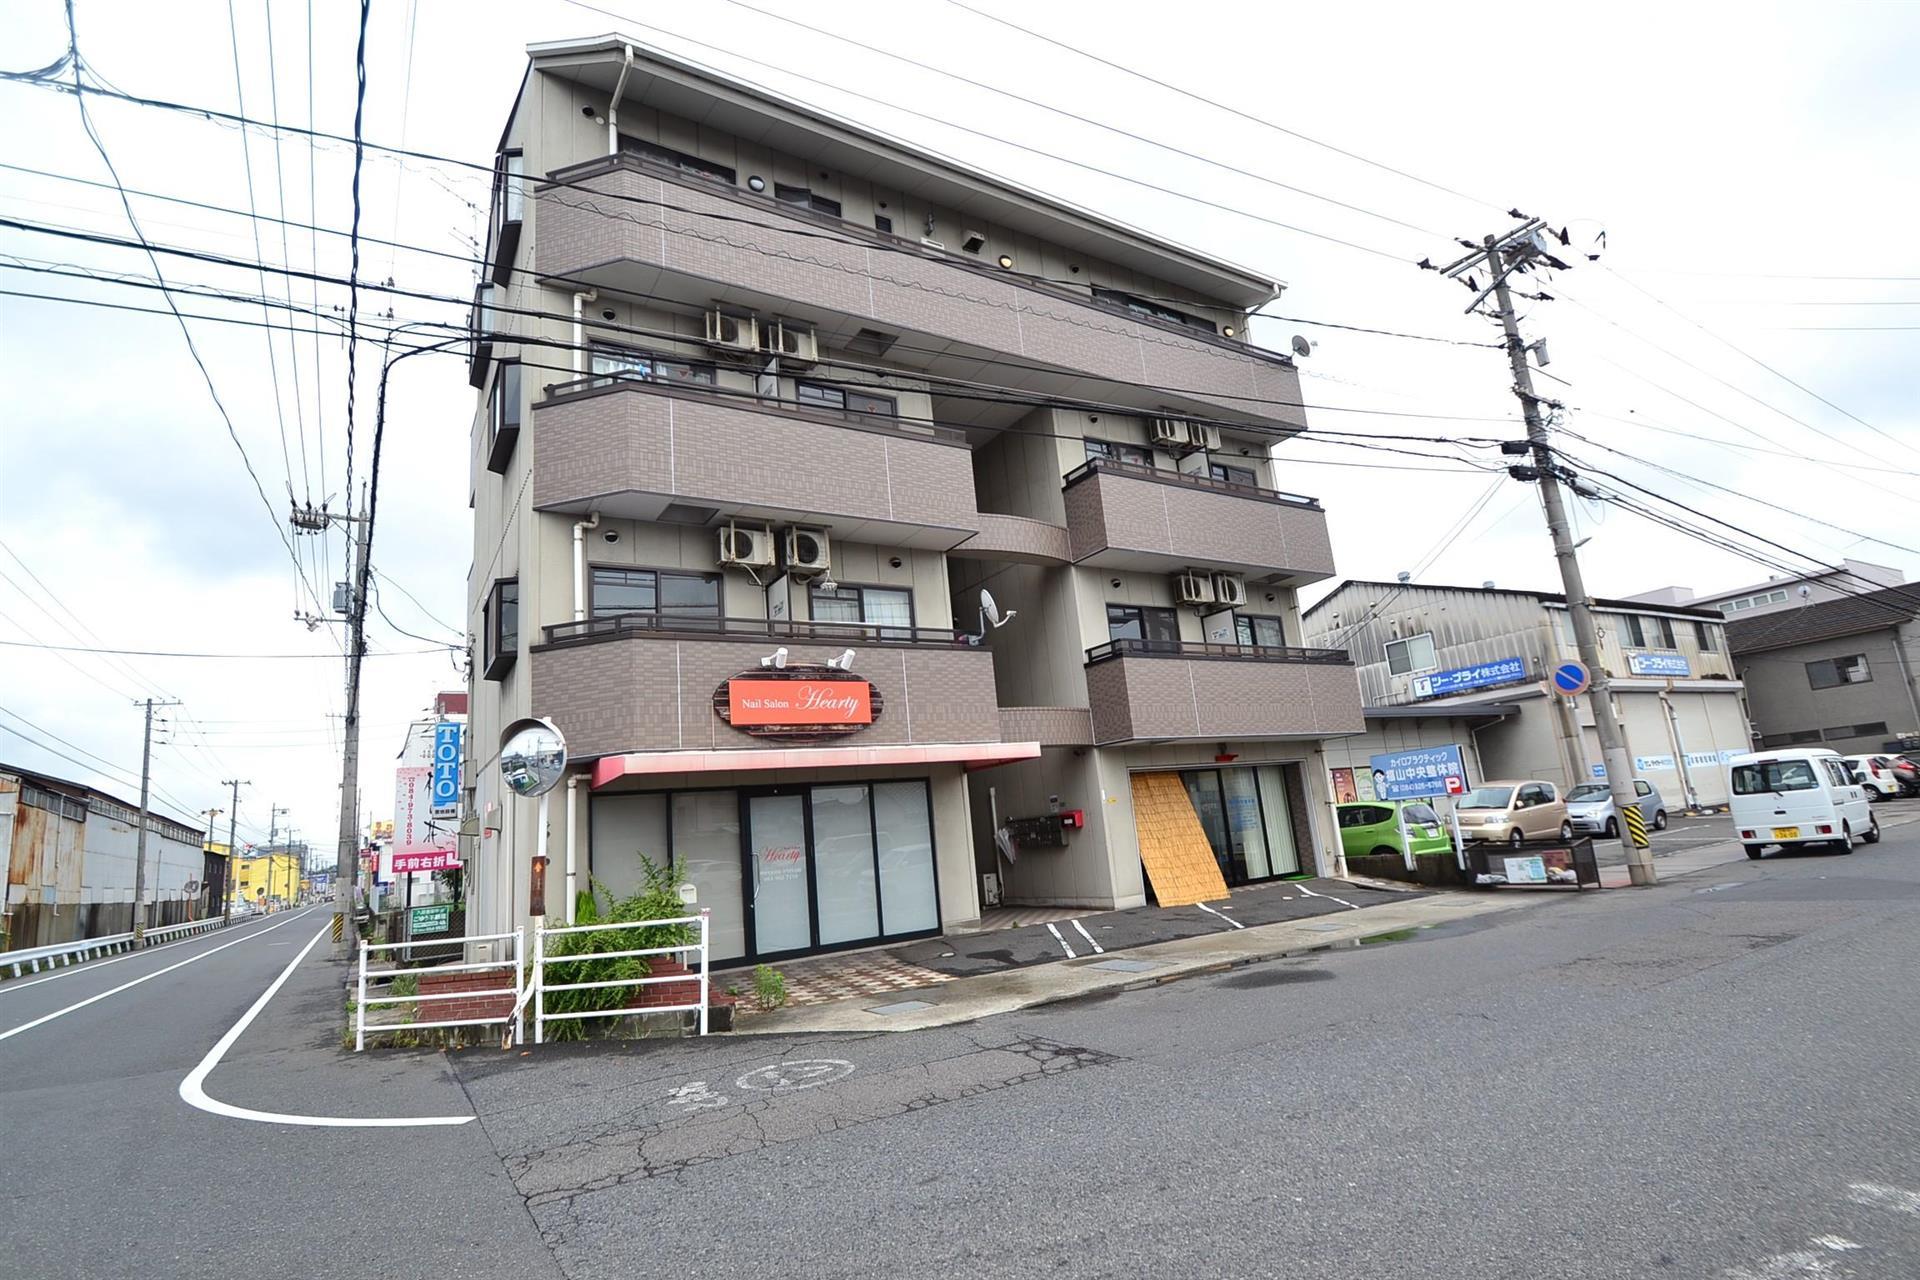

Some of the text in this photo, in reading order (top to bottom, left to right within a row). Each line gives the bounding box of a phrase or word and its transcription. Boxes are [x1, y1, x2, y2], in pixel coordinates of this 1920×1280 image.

[742, 685, 860, 719] Nail Salon Hearty
[436, 726, 458, 797] TOTO
[1445, 777, 1461, 794] P
[394, 855, 446, 871] 手前右折
